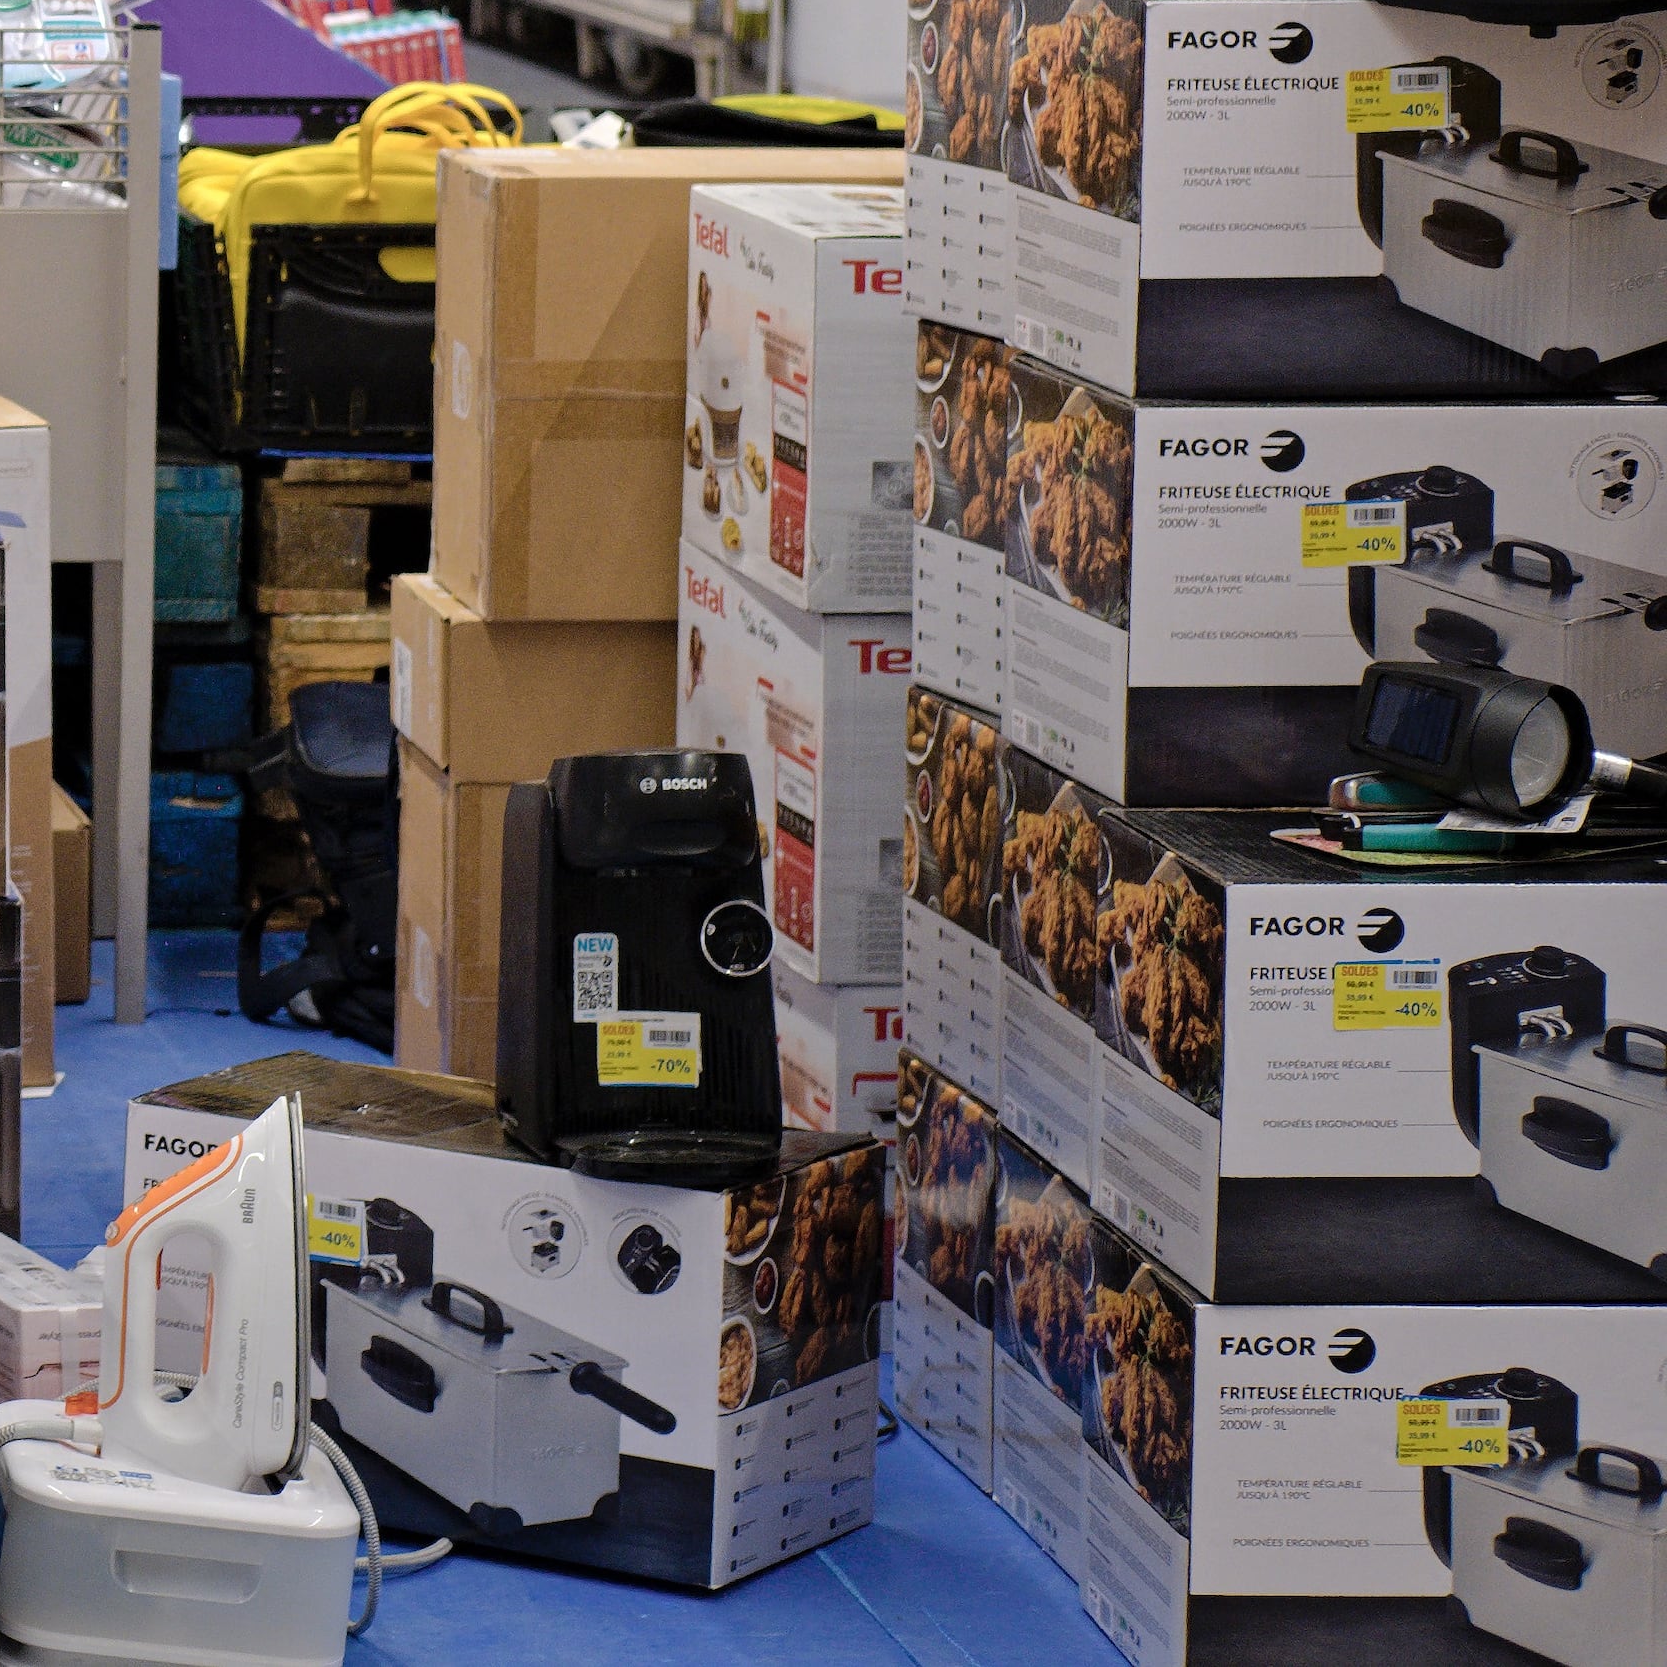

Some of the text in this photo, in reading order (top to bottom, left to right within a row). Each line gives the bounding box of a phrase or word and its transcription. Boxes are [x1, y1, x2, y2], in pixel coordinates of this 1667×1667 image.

[1167, 30, 1258, 50] FAGOR
[1167, 77, 1241, 92] FRITEUSE
[1244, 75, 1340, 93] ÉLECTRIQUE
[1166, 95, 1277, 107] Semi-professionnelle
[1166, 111, 1207, 121] 2000W
[693, 213, 730, 260] Tefal
[1159, 438, 1249, 457] FAGOR
[1158, 482, 1331, 501] FRITEUSE ÉLECTRIQUE
[1158, 502, 1268, 516] Semi-professionnelle
[1158, 518, 1198, 529] 2000W
[683, 565, 727, 619] Tefal
[661, 777, 708, 791] BOSCH
[1250, 916, 1345, 936] FAGOR
[577, 937, 614, 953] NEW
[1250, 966, 1325, 980] FRITEUSE
[1341, 965, 1379, 977] SOLDES
[1249, 1000, 1292, 1012] 2000W
[650, 1059, 691, 1075] -70%
[1266, 1059, 1392, 1069] TEMPÉRATURE RÉGLABLE
[1263, 1118, 1398, 1129] POIGNÉES ERGONOMIQUES
[242, 1187, 257, 1224] BRAUN
[1219, 1335, 1316, 1356] FAGOR
[1220, 1384, 1405, 1402] FRITEUSE ÉLECTRIQUE
[1219, 1404, 1337, 1417] Semi-professionnelle
[1402, 1403, 1441, 1415] SOLDES
